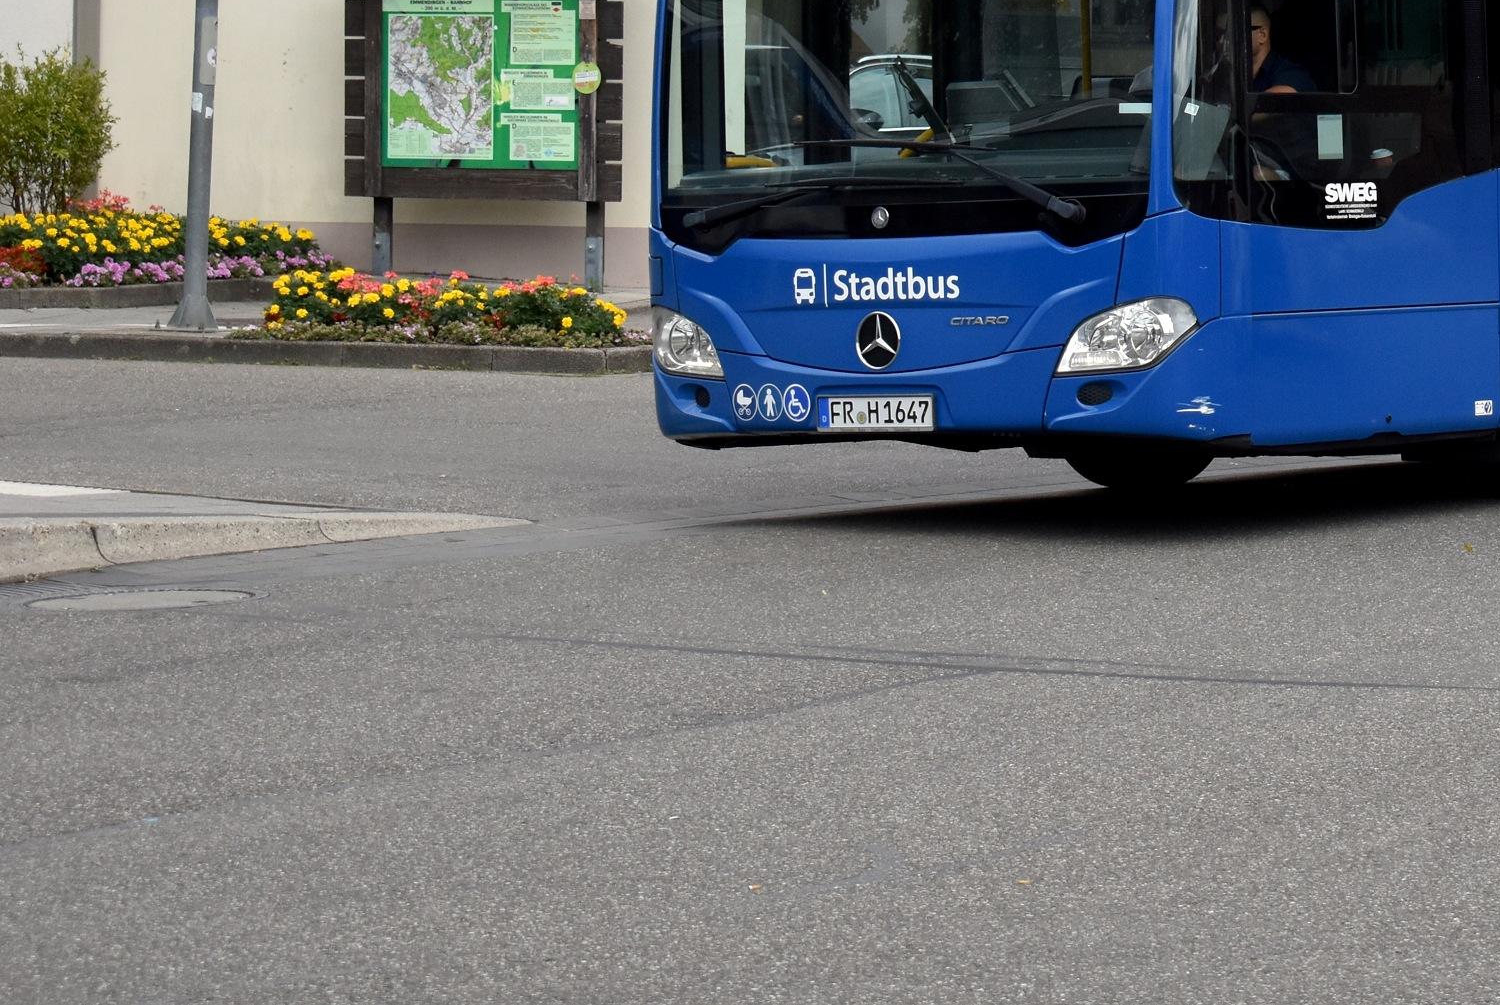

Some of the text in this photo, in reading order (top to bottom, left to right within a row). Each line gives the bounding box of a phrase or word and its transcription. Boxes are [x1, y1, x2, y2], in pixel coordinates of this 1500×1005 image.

[1325, 182, 1377, 203] SWEG
[833, 267, 960, 301] Stadtbus
[950, 315, 1009, 326] CITARO
[830, 401, 854, 424] FR
[867, 401, 879, 424] H
[883, 400, 929, 424] 1647
